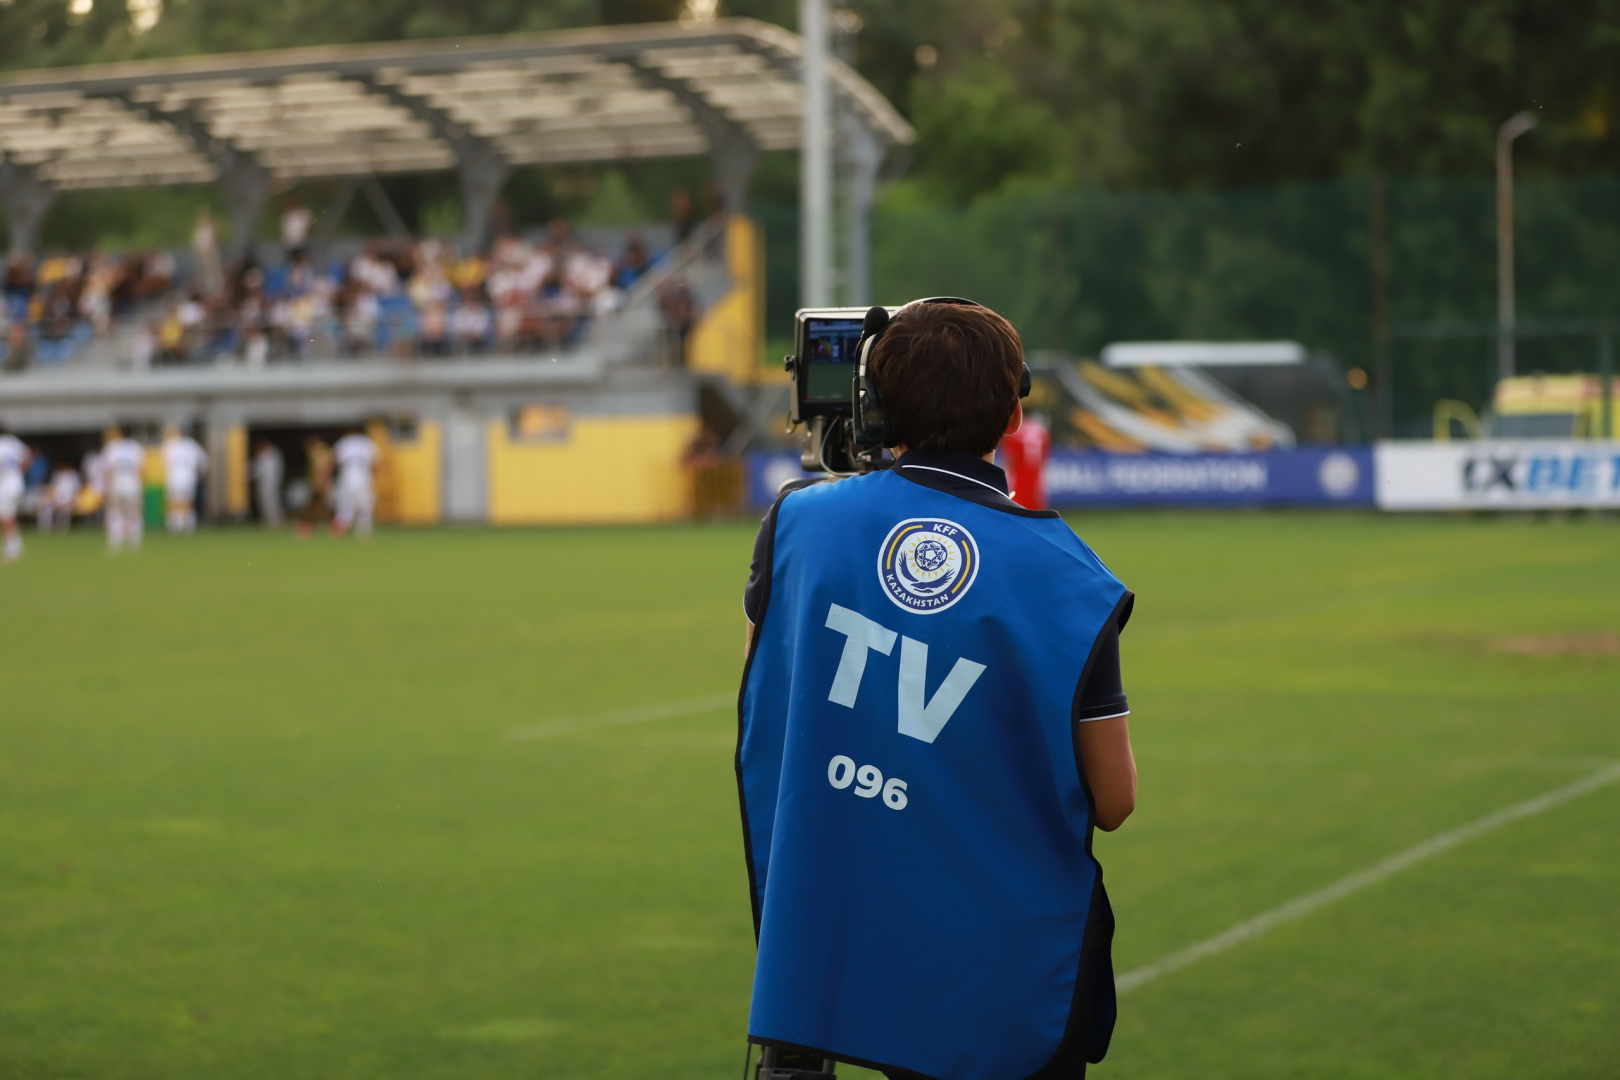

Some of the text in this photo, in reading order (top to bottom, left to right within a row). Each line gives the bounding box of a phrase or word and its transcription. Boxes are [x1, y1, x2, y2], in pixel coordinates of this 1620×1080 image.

[932, 523, 958, 536] KFF
[886, 573, 949, 607] KAZAKHSTAN
[824, 602, 988, 744] TV
[827, 754, 908, 811] 096
